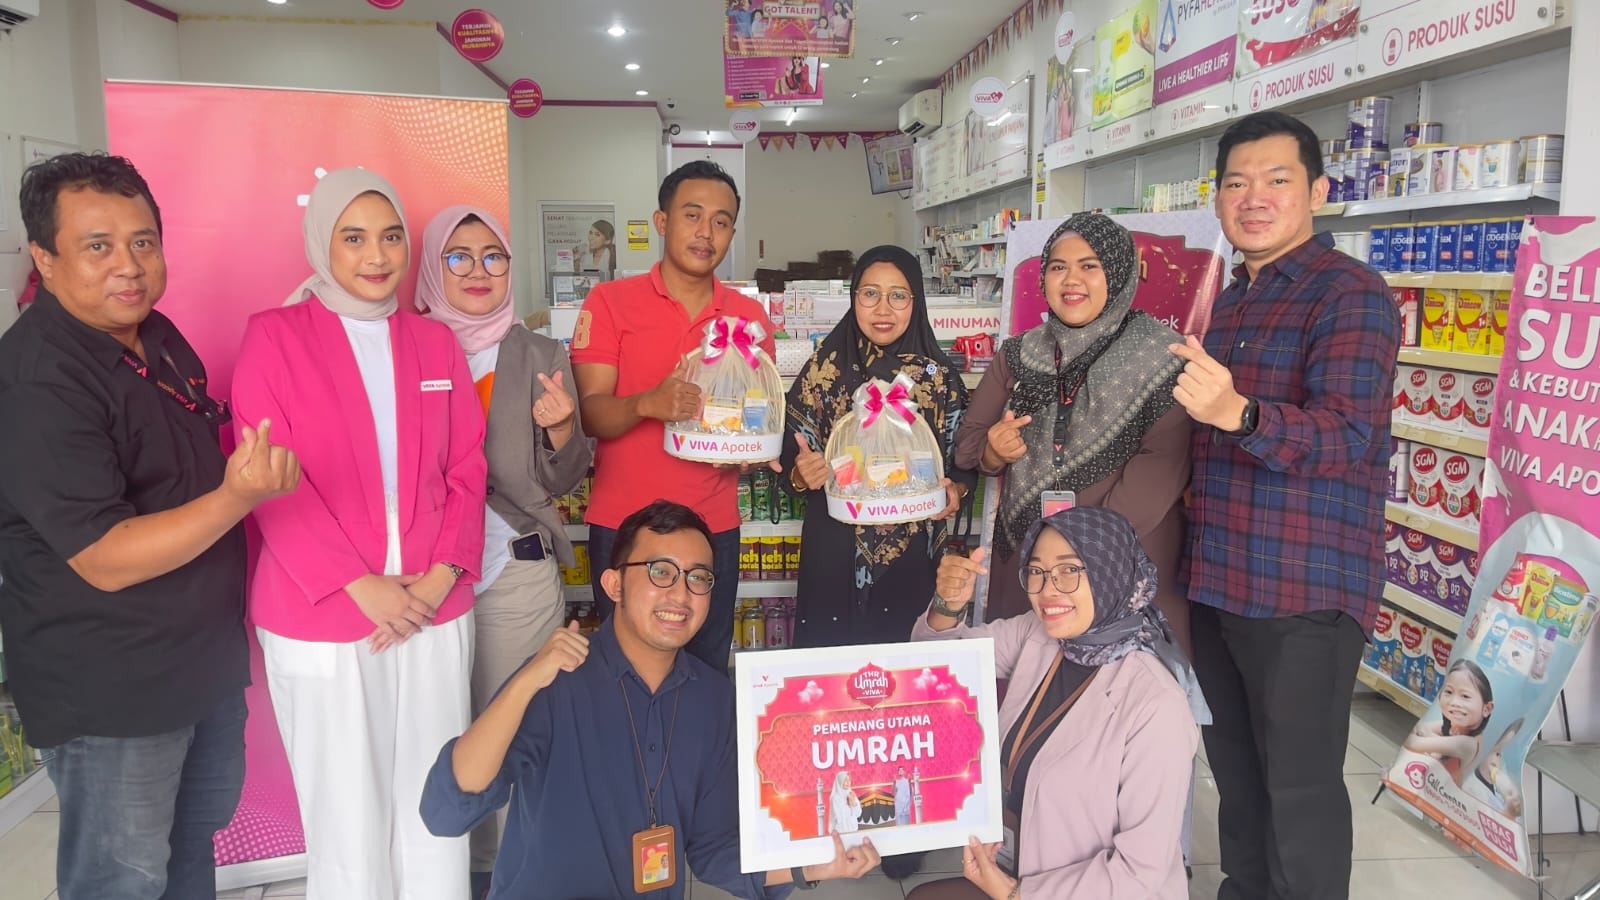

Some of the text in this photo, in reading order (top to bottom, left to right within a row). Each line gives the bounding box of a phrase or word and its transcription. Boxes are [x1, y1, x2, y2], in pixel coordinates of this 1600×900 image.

[764, 5, 818, 15] GOT TALENT
[1408, 0, 1516, 52] PRODUK SUSU
[1159, 75, 1171, 92] LIVE
[1177, 59, 1213, 84] HEALTHIER
[1265, 63, 1334, 101] PRODUK SUSU
[1179, 101, 1207, 117] VITAMIN
[1412, 372, 1427, 384] SGM
[1440, 376, 1454, 388] SGM
[1474, 381, 1492, 393] SGM
[1502, 399, 1599, 449] ANAK
[689, 440, 762, 455] VIVA Apotek
[1415, 456, 1435, 468] SGM
[1446, 462, 1467, 475] SGM
[1501, 445, 1542, 483] VIVA
[867, 499, 937, 517] VIVA Apotek
[1407, 532, 1423, 545] SGM
[761, 549, 783, 564] teh
[1439, 544, 1454, 557] SGM
[855, 676, 888, 689] Umrah
[813, 714, 931, 736] PEMENANG UTAMA
[811, 731, 935, 770] UMRAH
